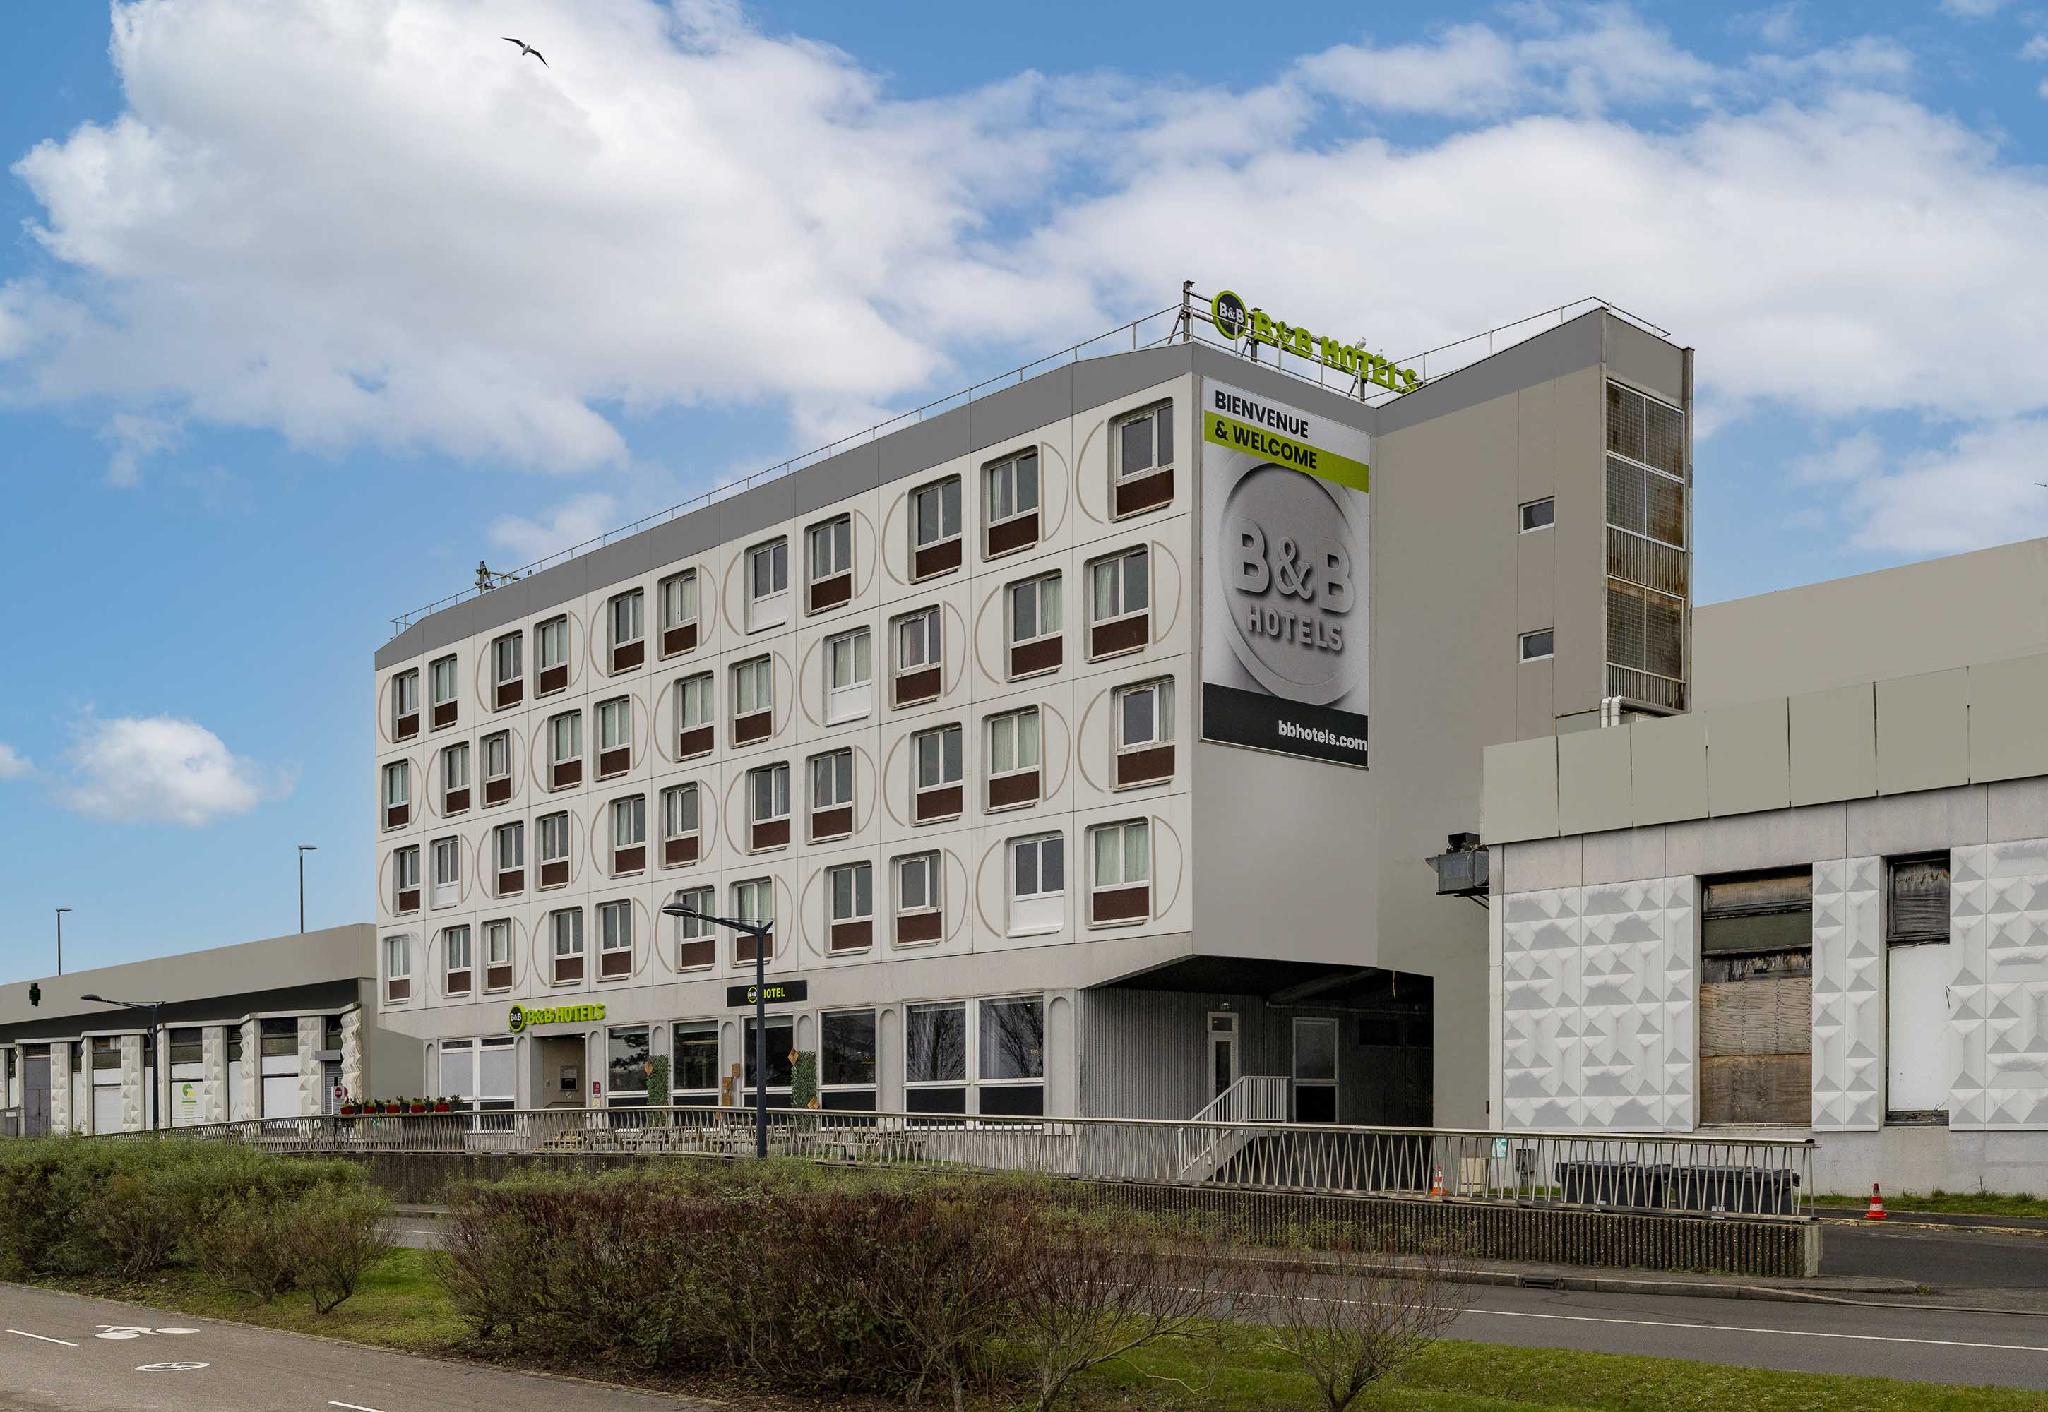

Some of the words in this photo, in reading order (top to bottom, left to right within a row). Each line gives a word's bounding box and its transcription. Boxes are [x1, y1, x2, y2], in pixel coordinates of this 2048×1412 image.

[1219, 301, 1245, 324] B&B
[1320, 335, 1419, 395] HOTELS
[1214, 389, 1309, 439] BIENVENUE
[1214, 420, 1228, 441] &
[1232, 424, 1317, 470] WELCOME
[1231, 516, 1355, 614] B&B
[1248, 604, 1344, 651] HOTELS
[1278, 719, 1368, 751] bbhotels.com
[526, 1007, 554, 1025] B&B
[554, 1003, 606, 1023] HOTELS
